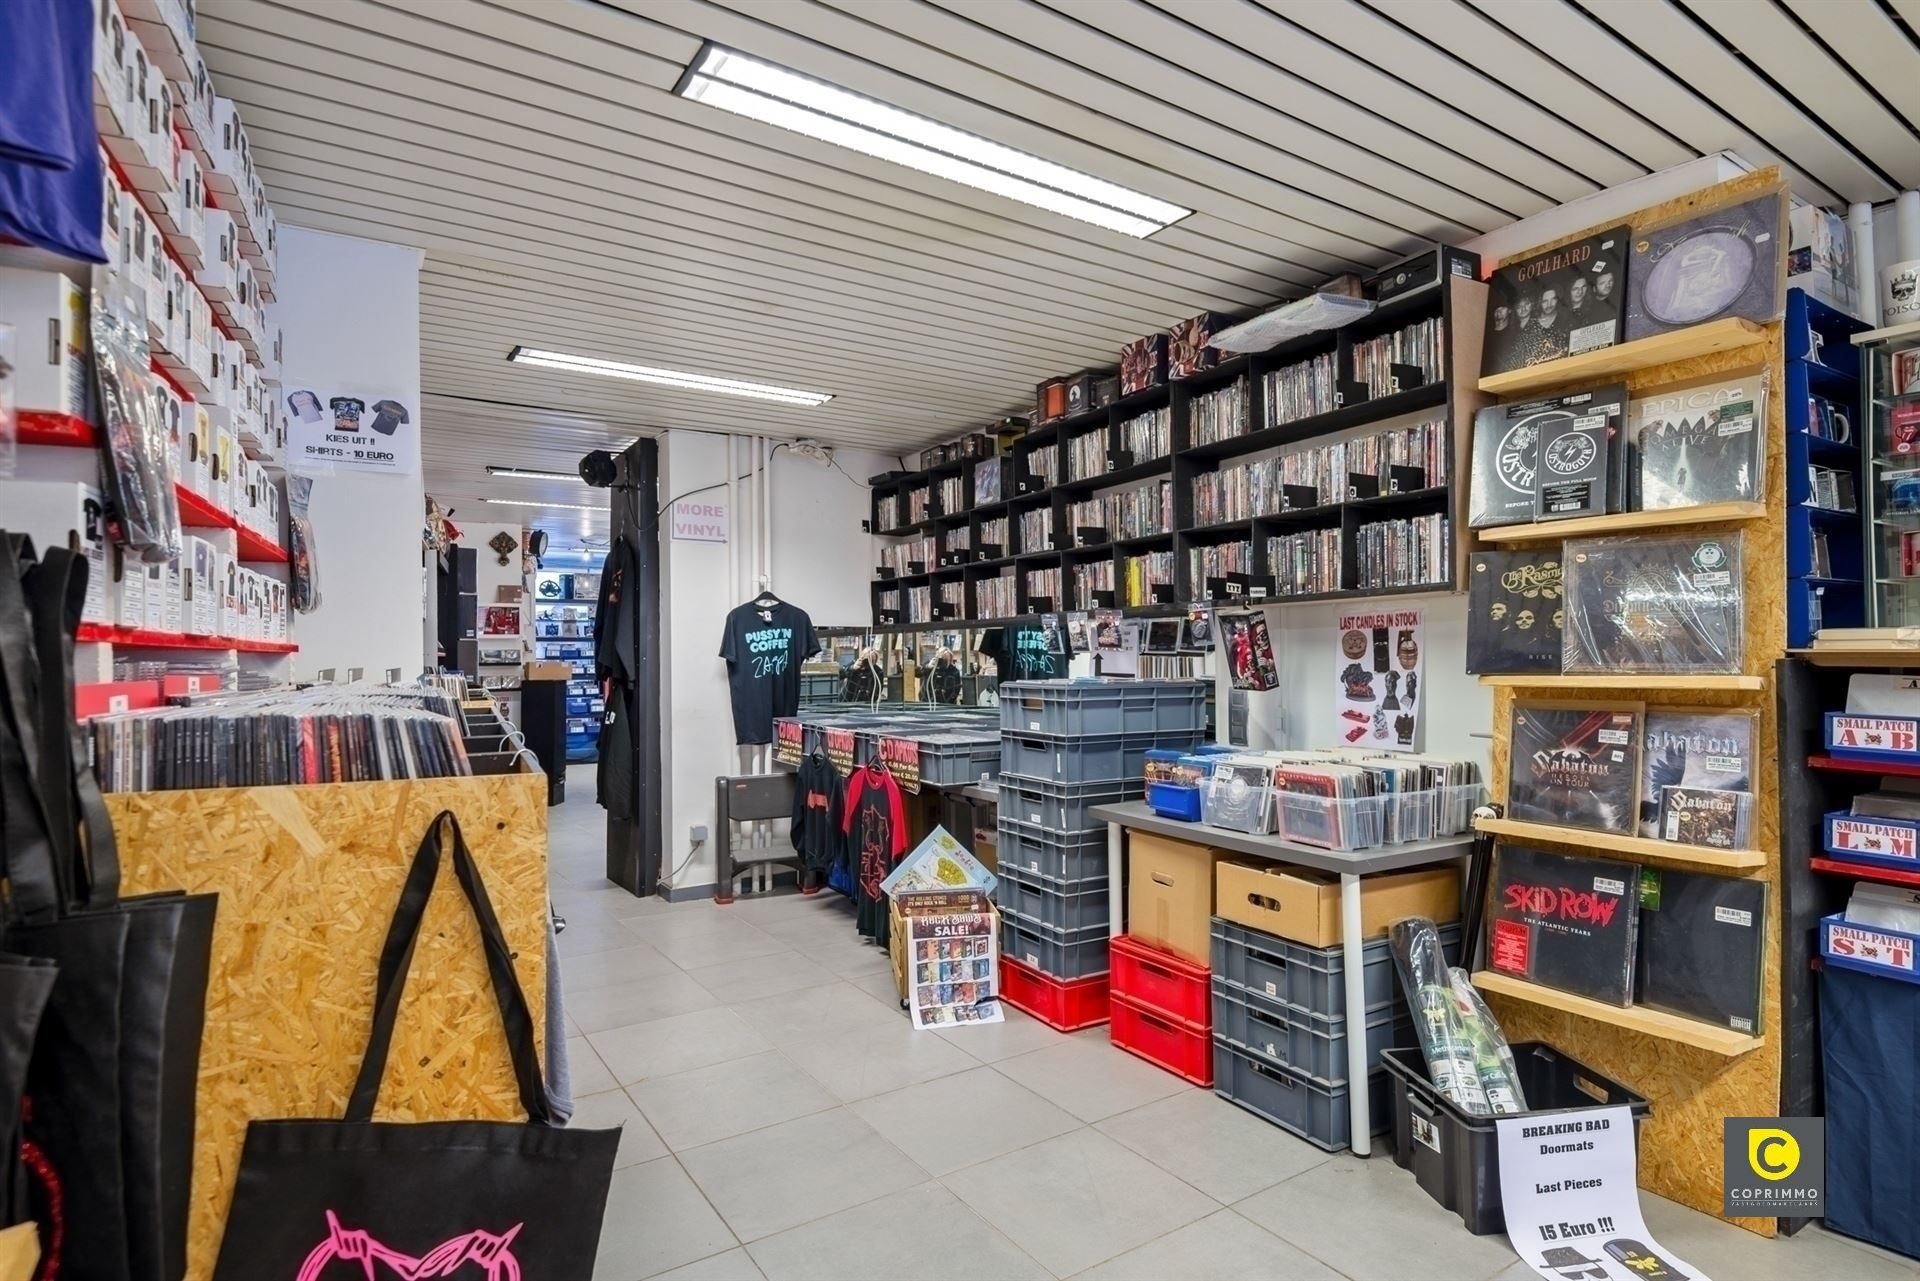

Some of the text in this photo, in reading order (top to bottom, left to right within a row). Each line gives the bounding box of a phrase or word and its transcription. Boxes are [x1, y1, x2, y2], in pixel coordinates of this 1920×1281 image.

[1642, 388, 1729, 417] EPICA
[326, 434, 349, 444] KIES
[352, 436, 367, 445] UIT
[305, 446, 343, 456] SHIRTS
[354, 450, 364, 458] 10
[367, 451, 394, 460] EURO
[1548, 448, 1593, 472] OSTROGOTH
[1502, 452, 1535, 487] OSTR
[676, 503, 724, 517] MORE
[675, 523, 725, 537] VINYL
[1519, 565, 1562, 585] Rasmu
[1340, 616, 1355, 630] LAST
[1357, 614, 1384, 628] CANDLES
[1386, 614, 1393, 626] IN
[1395, 612, 1417, 626] STOCK
[745, 629, 780, 643] PUSSY
[749, 639, 789, 653] COFFEE
[1837, 718, 1914, 732] SMALL PATCH
[1647, 731, 1739, 757] abaton
[1839, 729, 1914, 749] A B
[1530, 749, 1609, 778] Sabaton
[1670, 791, 1733, 812] Sabaton
[1836, 821, 1913, 839] SMALL PATCH
[1837, 831, 1913, 857] L M
[1559, 887, 1619, 927] ROW
[934, 925, 969, 937] SALE!
[1538, 920, 1569, 931] ATLANTIC
[1570, 927, 1592, 936] YEARS
[1832, 927, 1910, 949] SMALL PATCH
[1833, 938, 1909, 967] S T
[1522, 1119, 1610, 1138] BREAKING BAD
[1540, 1141, 1594, 1155] Doormats
[1536, 1178, 1603, 1194] Last Pieces
[1539, 1216, 1616, 1241] 15 Euro !!!
